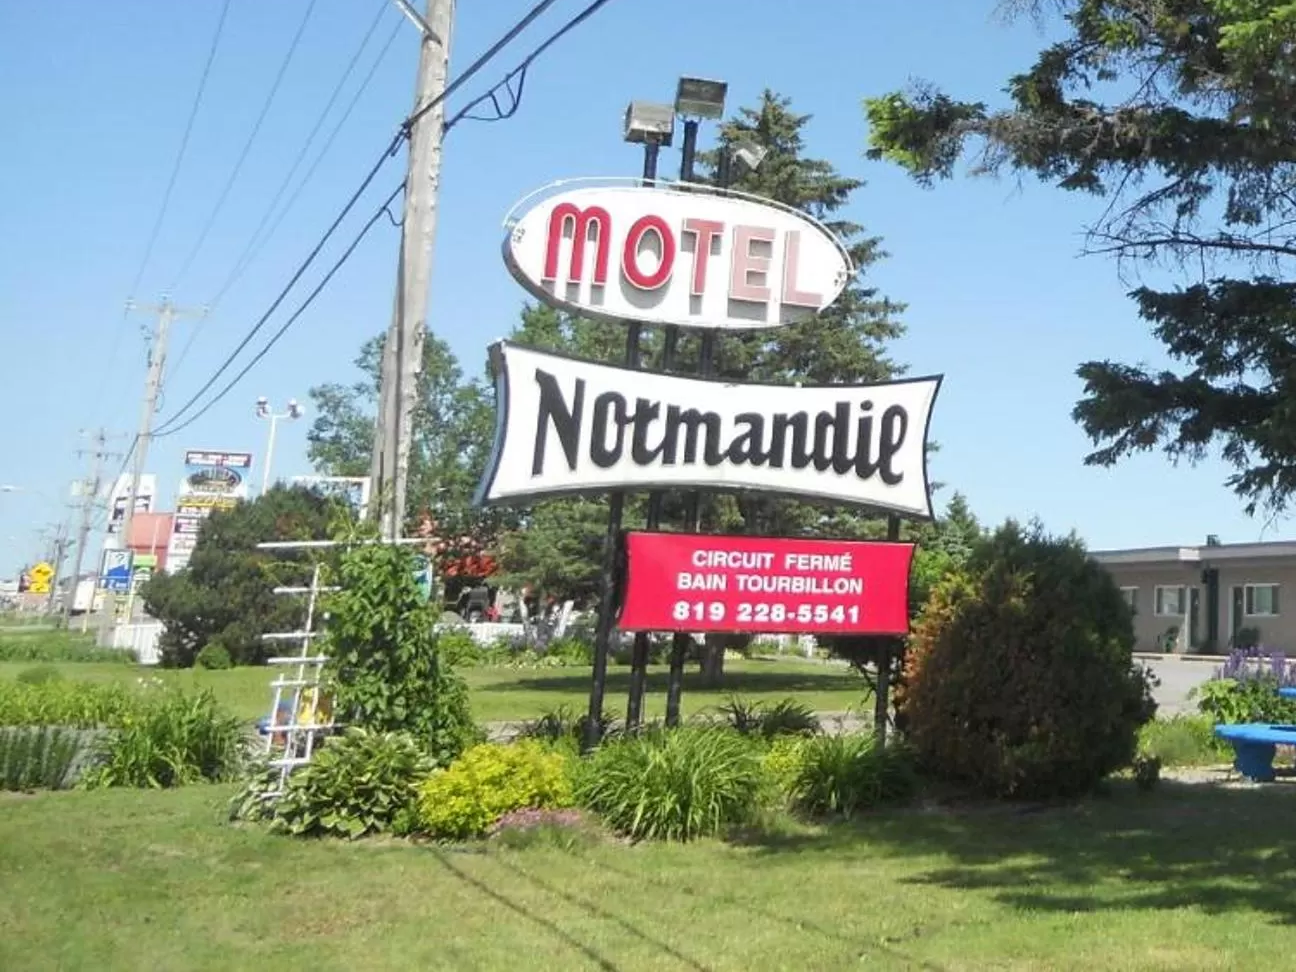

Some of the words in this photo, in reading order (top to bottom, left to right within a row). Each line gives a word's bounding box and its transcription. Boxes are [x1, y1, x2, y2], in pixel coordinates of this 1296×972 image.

[542, 201, 823, 308] MOTEL
[532, 368, 909, 485] Normandie
[692, 550, 775, 569] CIRCUIT
[785, 553, 852, 571] FERMÉ
[677, 572, 727, 591] BAIN
[735, 574, 863, 595] TOURBILLON
[673, 601, 726, 621] 819
[736, 603, 860, 624] 228-5541
